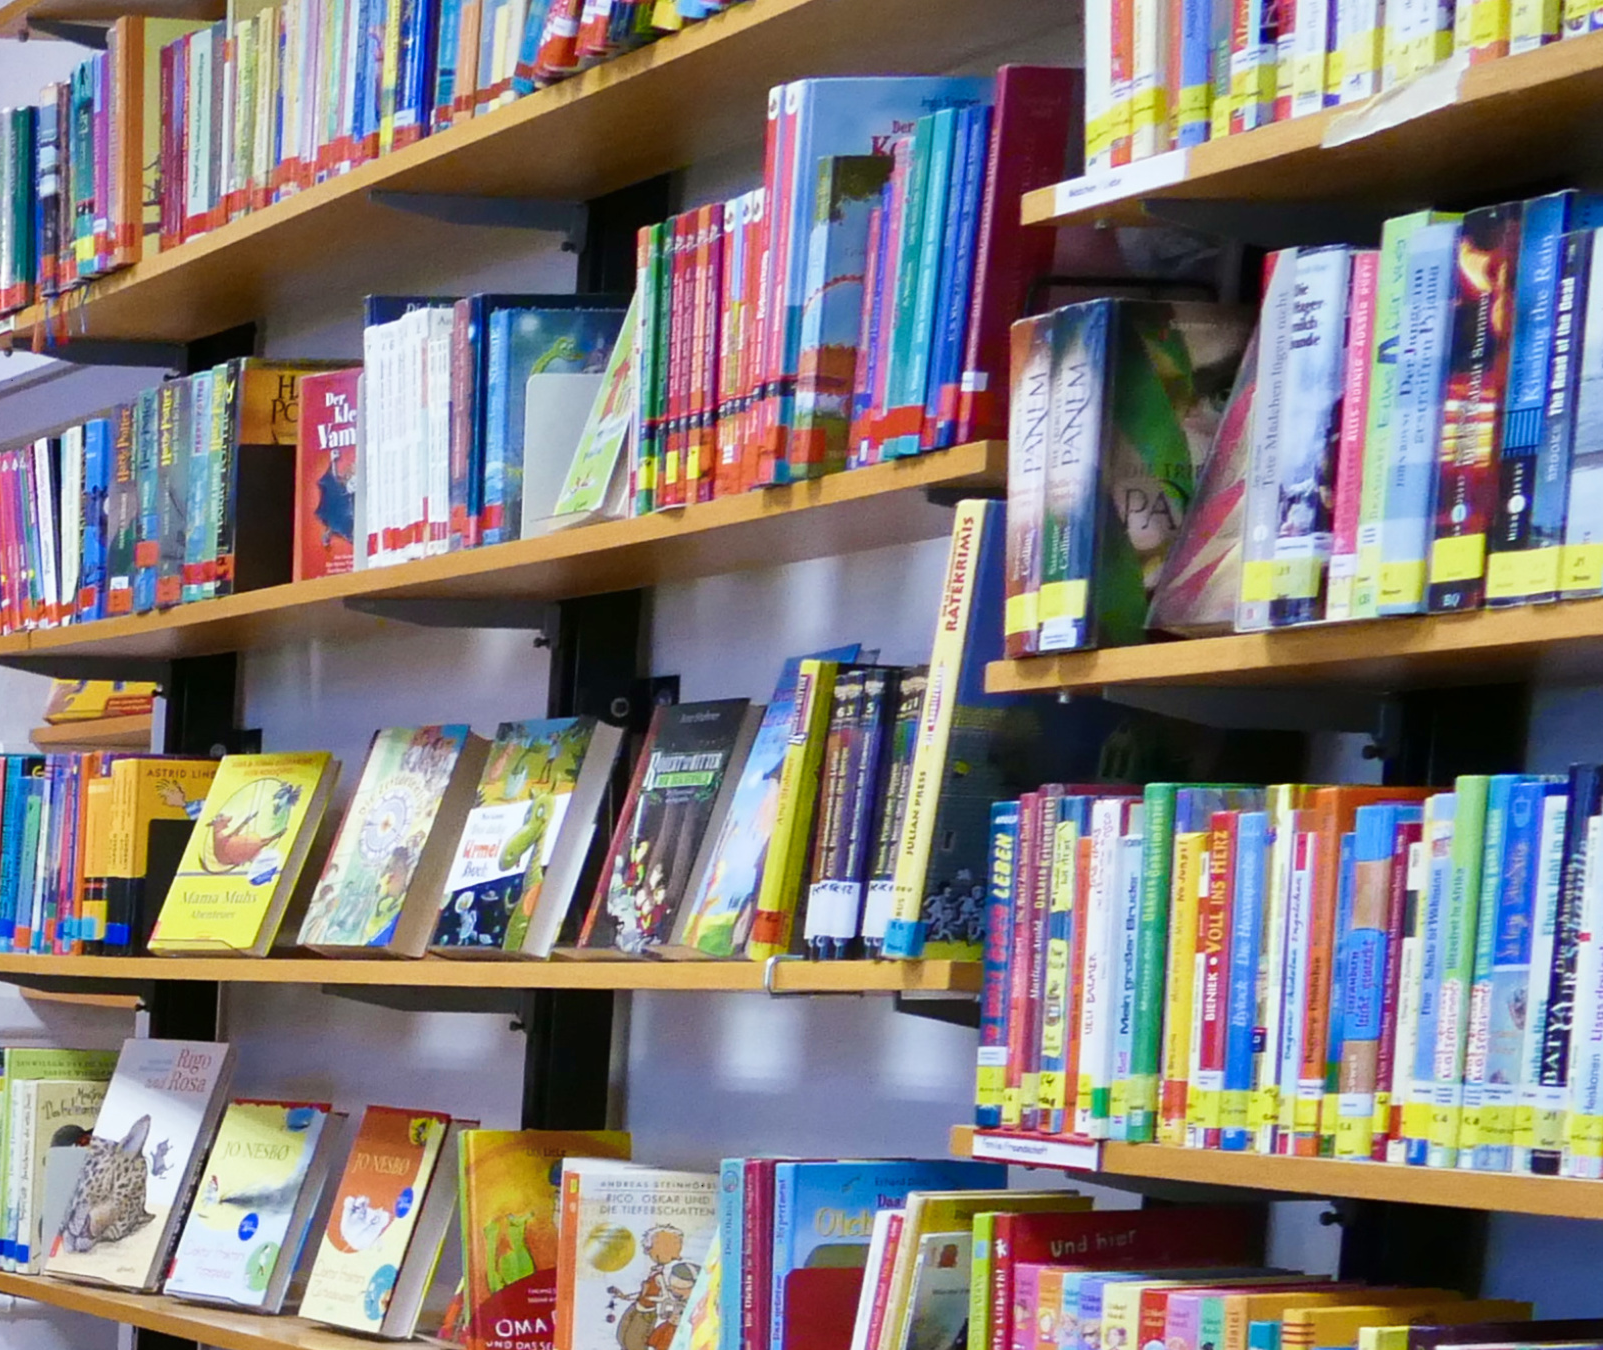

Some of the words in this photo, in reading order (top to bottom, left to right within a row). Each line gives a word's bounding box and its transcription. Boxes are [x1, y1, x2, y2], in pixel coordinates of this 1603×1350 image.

[1532, 234, 1553, 284] Rain
[1276, 291, 1289, 330] nicht
[1530, 289, 1547, 322] the
[1400, 357, 1414, 396] Der
[1408, 268, 1424, 295] im
[1268, 335, 1289, 375] lügen
[1524, 325, 1549, 402] Kissing
[160, 389, 172, 430] Potter
[325, 393, 345, 407] Der
[1061, 361, 1090, 467] PANEM
[1263, 380, 1284, 449] Mädchen
[117, 408, 130, 447] Potter
[317, 424, 356, 450] Vam
[1024, 371, 1049, 474] PANEM
[1261, 455, 1277, 489] Tote
[945, 515, 976, 632] RATEKRIMIS
[905, 811, 920, 856] JULIAN
[913, 770, 927, 811] PRESS
[992, 832, 1013, 898] LEBEN
[1210, 830, 1229, 874] HERZ
[182, 890, 227, 907] Mama
[1125, 872, 1139, 931] Bruder
[1209, 881, 1226, 905] INS
[1206, 911, 1225, 953] VOLL
[1123, 934, 1136, 991] großer
[1120, 994, 1132, 1035] Mein
[1205, 971, 1218, 1021] BIENIEK
[175, 1048, 213, 1072] Rigo
[167, 1069, 207, 1093] Rosa
[221, 1140, 241, 1158] JO
[244, 1142, 291, 1162] NESBØ
[353, 1152, 370, 1172] JO
[371, 1155, 411, 1176] NESBØ
[599, 1205, 619, 1216] DIE
[621, 1205, 716, 1217] TIEFERSCHATTEN
[1051, 1238, 1089, 1258] Und
[1096, 1229, 1138, 1251] hier
[993, 1268, 1007, 1324] Lisbeth!
[495, 1316, 547, 1337] OMA
